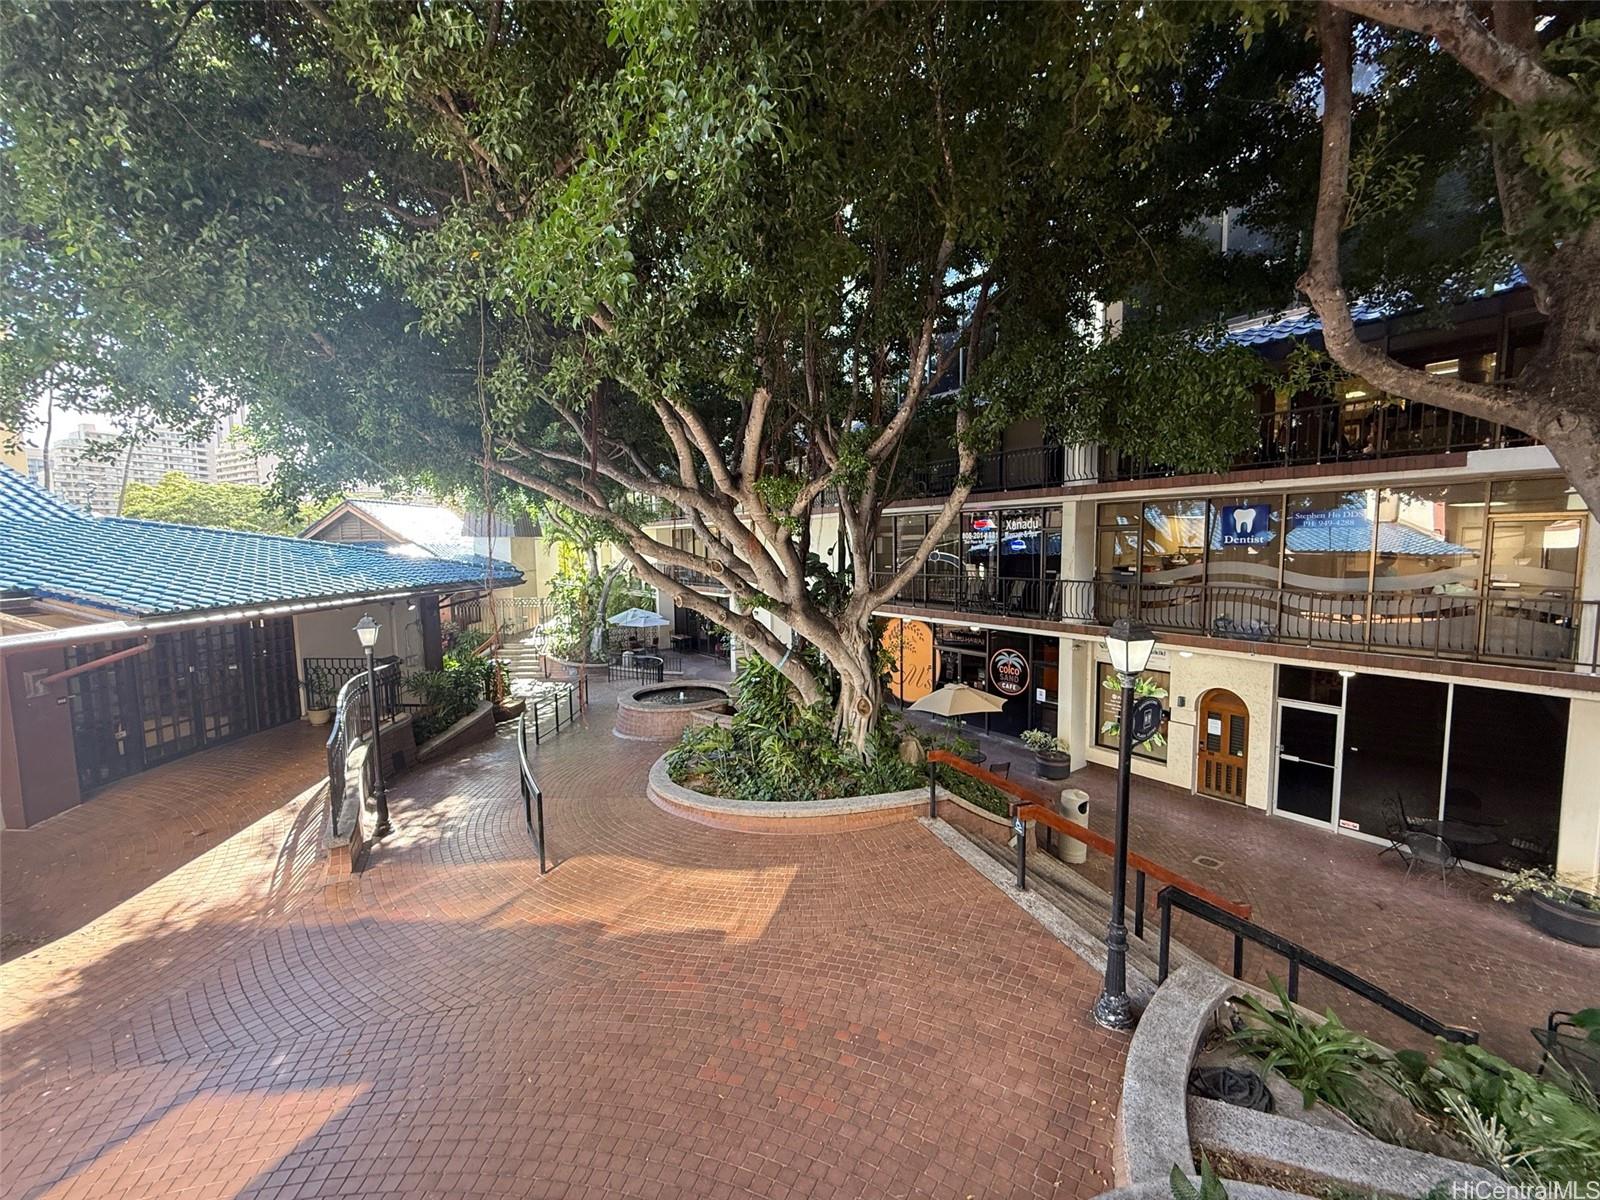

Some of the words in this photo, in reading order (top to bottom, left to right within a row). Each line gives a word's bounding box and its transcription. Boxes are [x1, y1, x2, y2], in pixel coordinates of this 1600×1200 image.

[1294, 512, 1326, 521] Stephen
[1005, 517, 1039, 530] Xanadu
[1224, 535, 1264, 544] Dentist
[1000, 673, 1020, 683] SAND
[1002, 682, 1017, 691] CAFE
